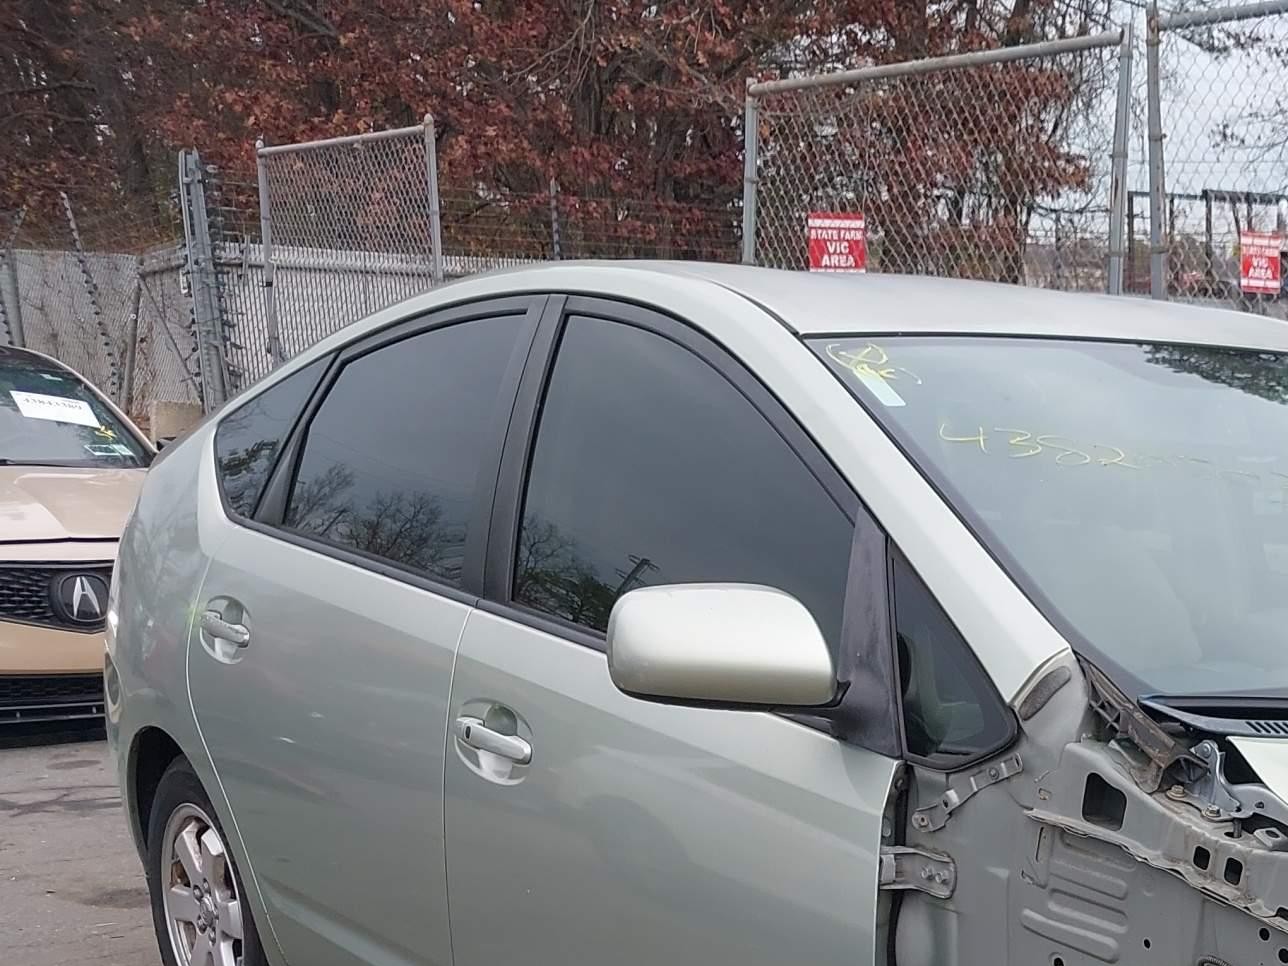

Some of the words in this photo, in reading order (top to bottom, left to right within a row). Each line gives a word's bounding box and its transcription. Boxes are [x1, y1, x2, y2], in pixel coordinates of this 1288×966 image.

[810, 229, 839, 240] STATE
[826, 241, 850, 254] VIC
[821, 254, 856, 268] AREA
